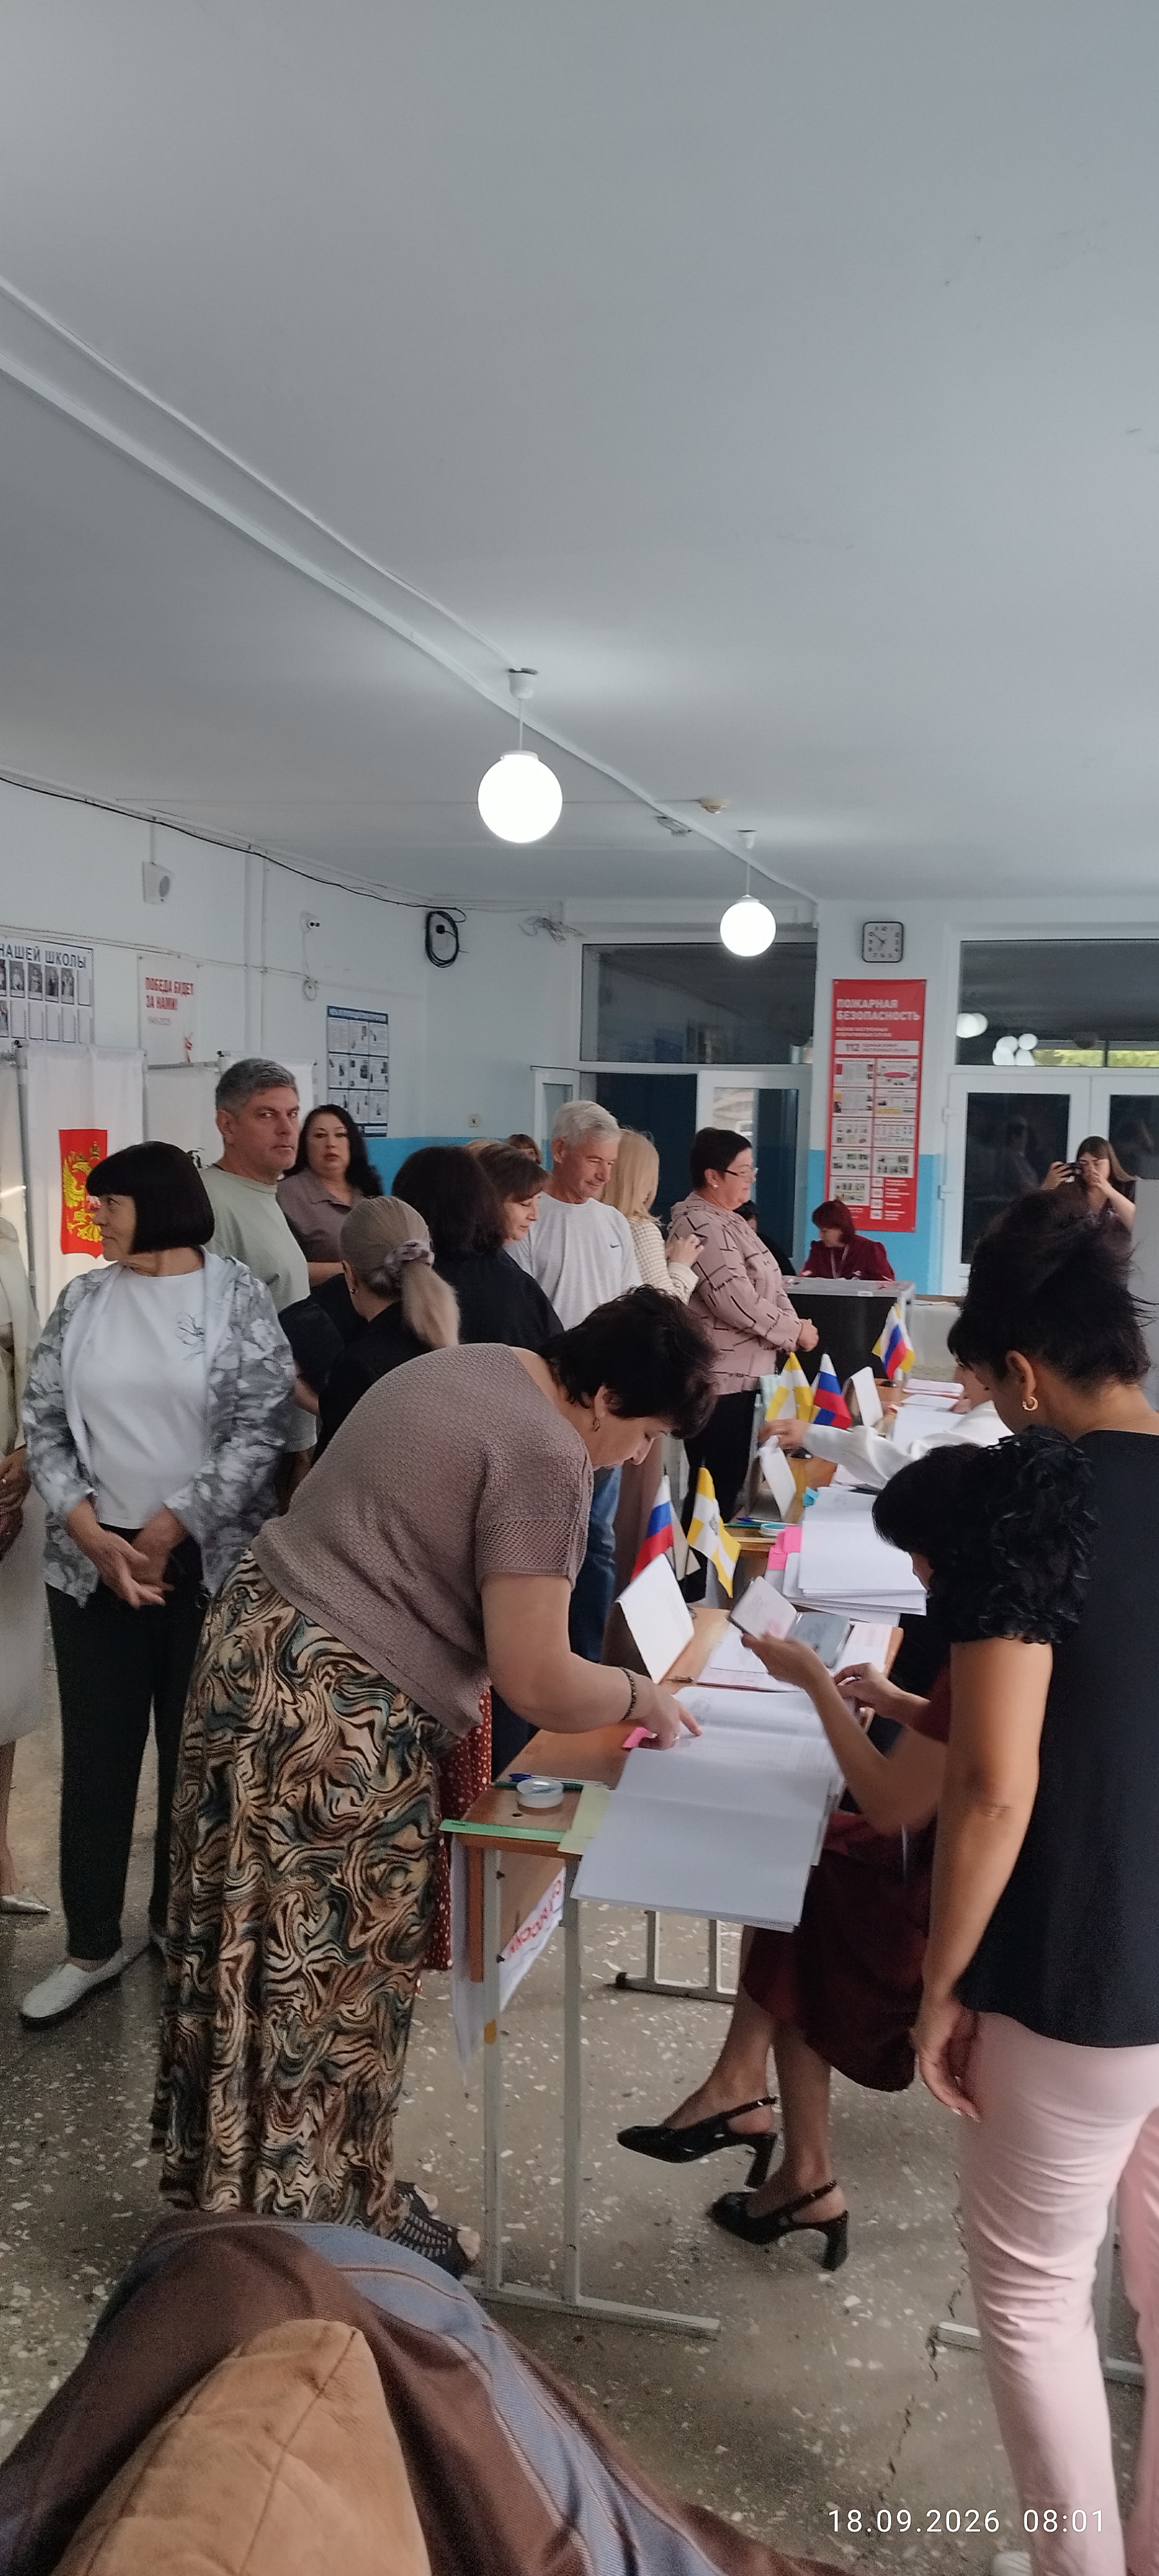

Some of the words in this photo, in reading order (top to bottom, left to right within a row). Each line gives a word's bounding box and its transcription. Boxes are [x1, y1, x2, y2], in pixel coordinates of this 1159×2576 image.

[0, 943, 41, 962] НАШЕЙ
[45, 950, 87, 969] ШКОЛЫ
[145, 977, 173, 994] ПОБЕДА
[174, 981, 194, 996] БУДЕТ
[146, 995, 155, 1009] ЗА
[836, 999, 898, 1009] ПОЖАРНАЯ
[836, 1010, 920, 1021] БЕЗОПАСНОСТЬ
[845, 1043, 860, 1052] 112
